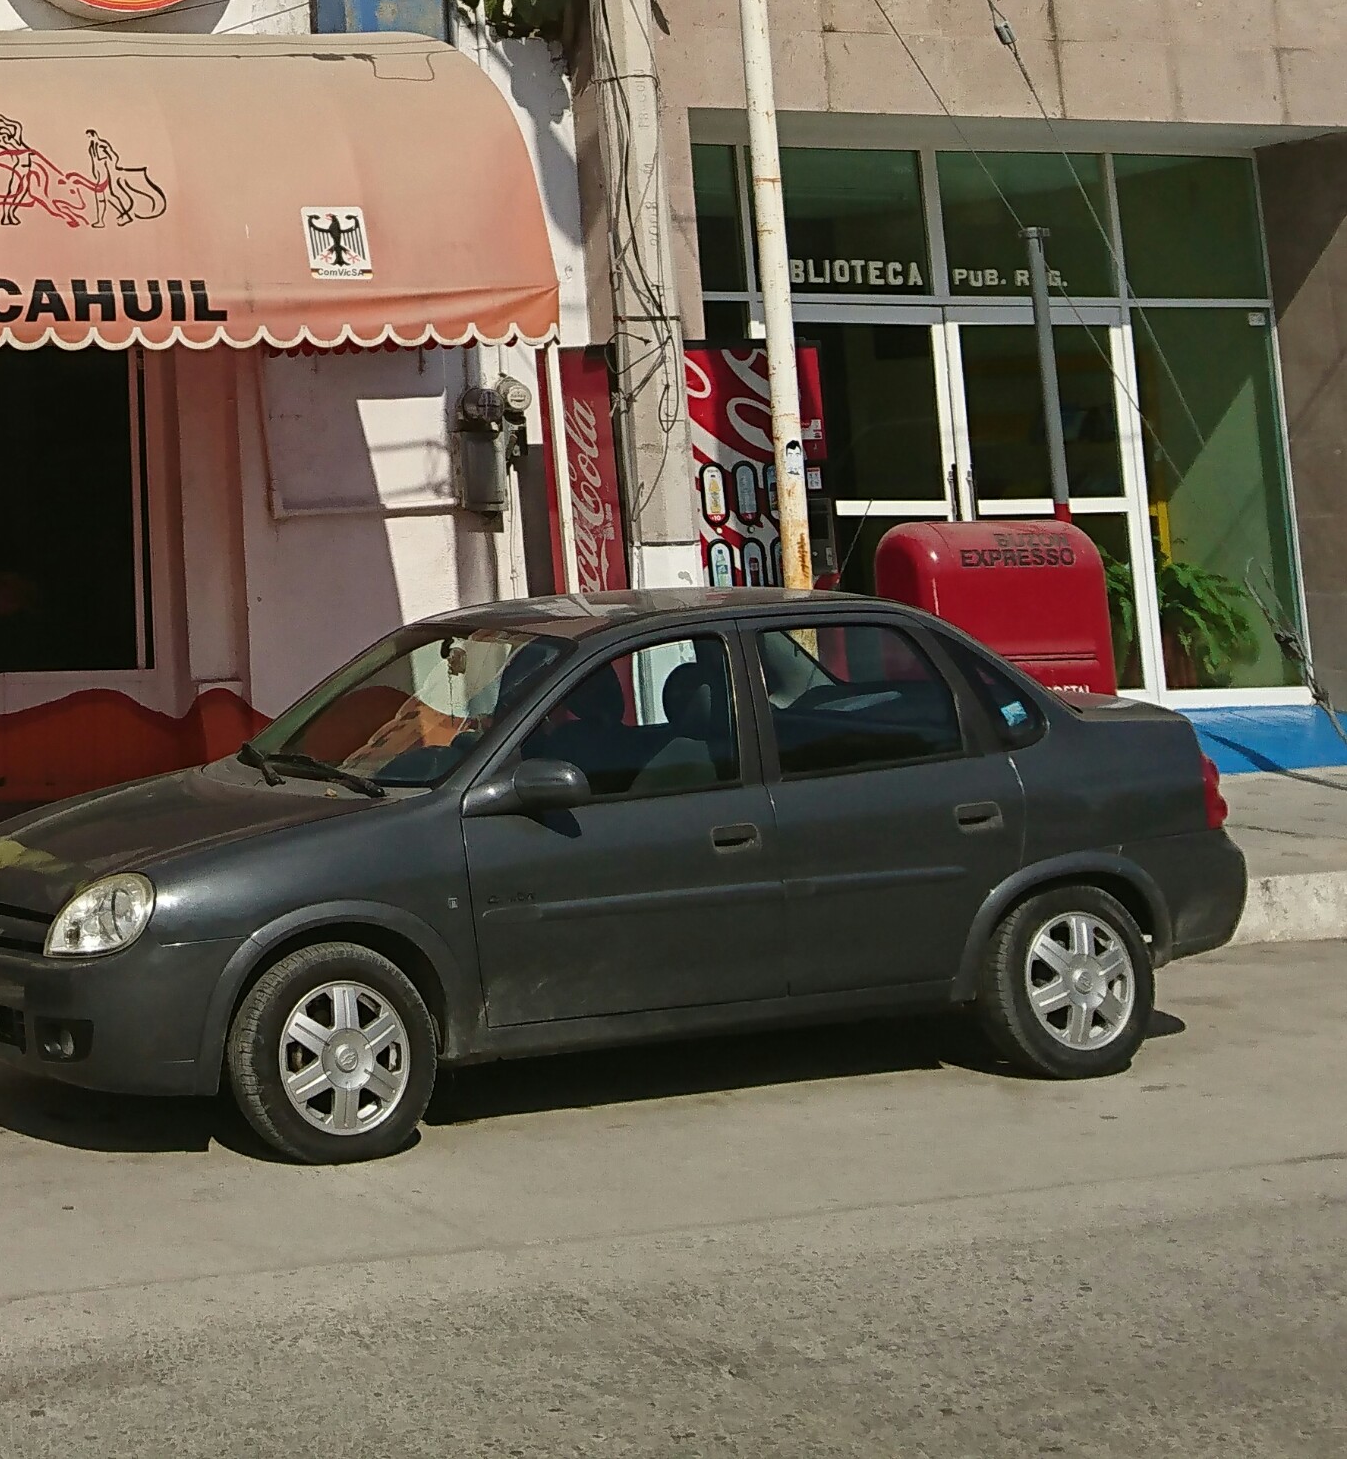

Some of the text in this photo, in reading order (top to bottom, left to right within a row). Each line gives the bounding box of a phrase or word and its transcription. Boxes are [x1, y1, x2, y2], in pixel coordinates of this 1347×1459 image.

[317, 268, 365, 277] ComVicSA
[789, 258, 924, 286] BLIOTECA
[952, 268, 1068, 288] PUB. RG.
[960, 547, 1075, 568] EXPRESSO
